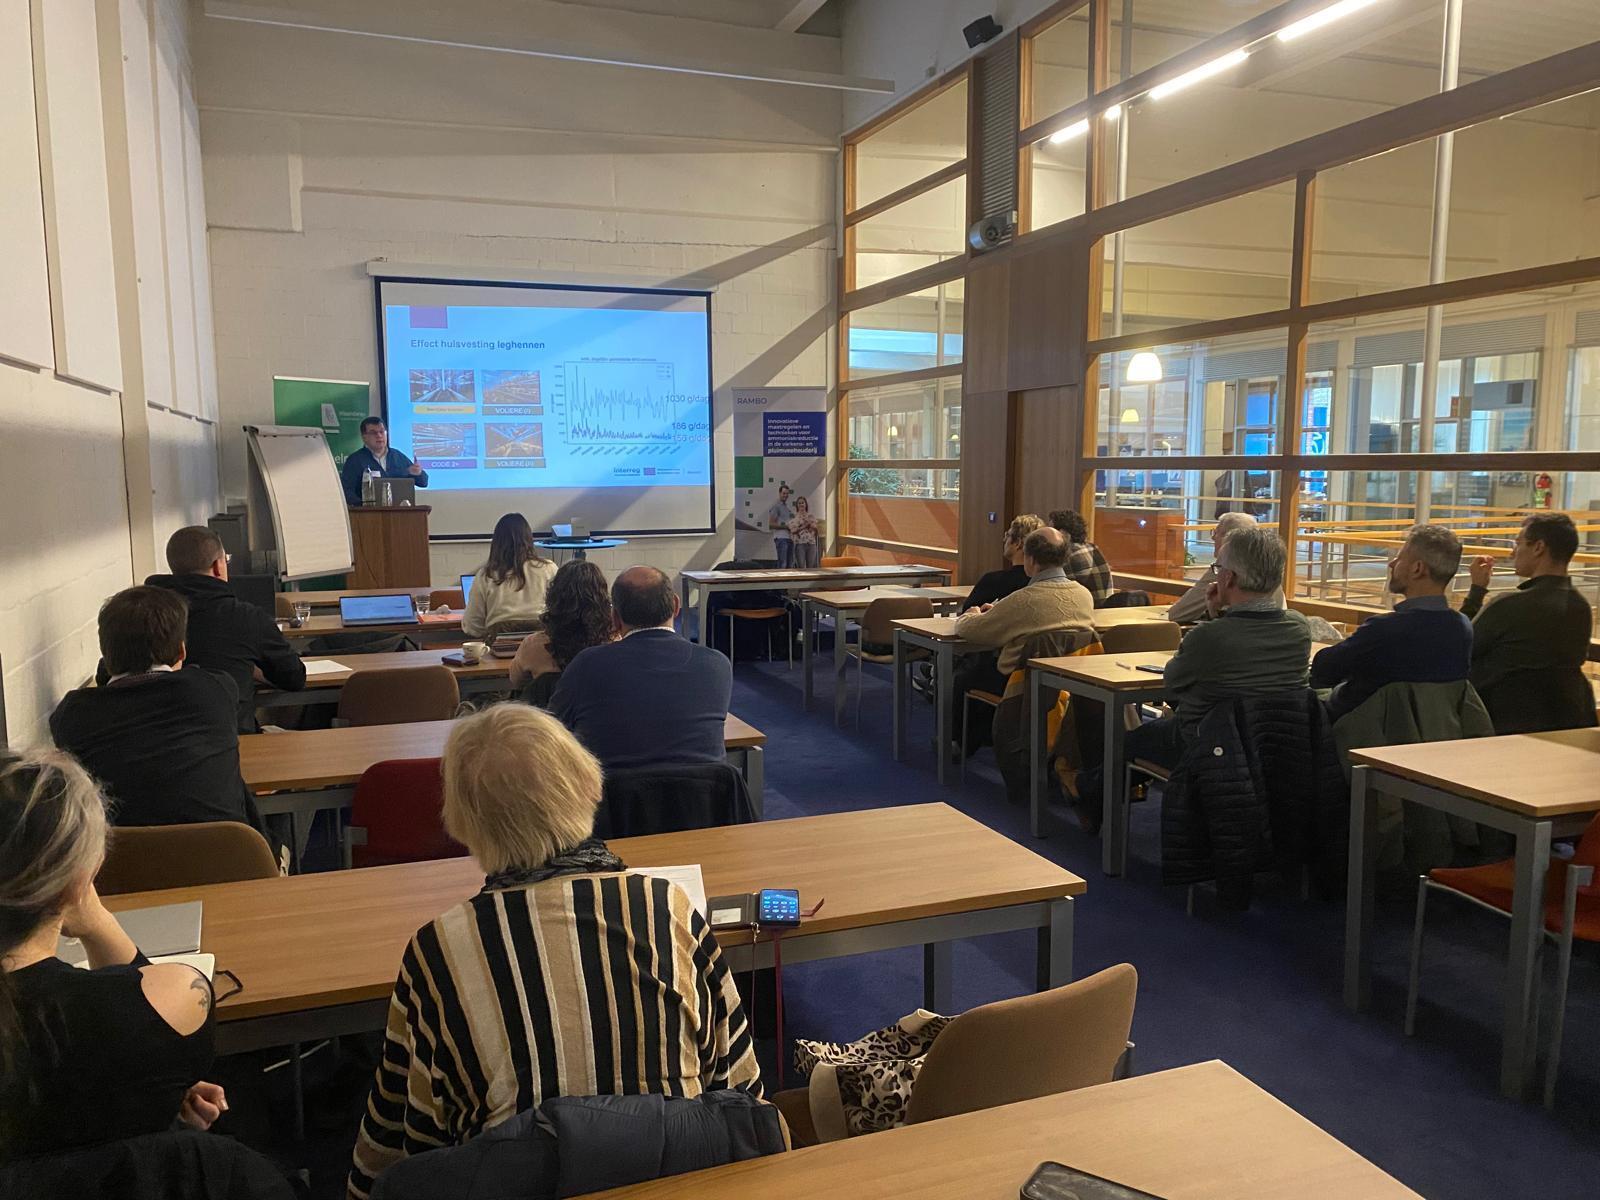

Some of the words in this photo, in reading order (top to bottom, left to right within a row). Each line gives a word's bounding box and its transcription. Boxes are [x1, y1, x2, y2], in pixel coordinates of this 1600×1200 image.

[410, 339, 438, 348] Effect
[441, 339, 495, 350] huisvesting
[497, 340, 545, 351] leghennen
[736, 397, 767, 405] RAMBO
